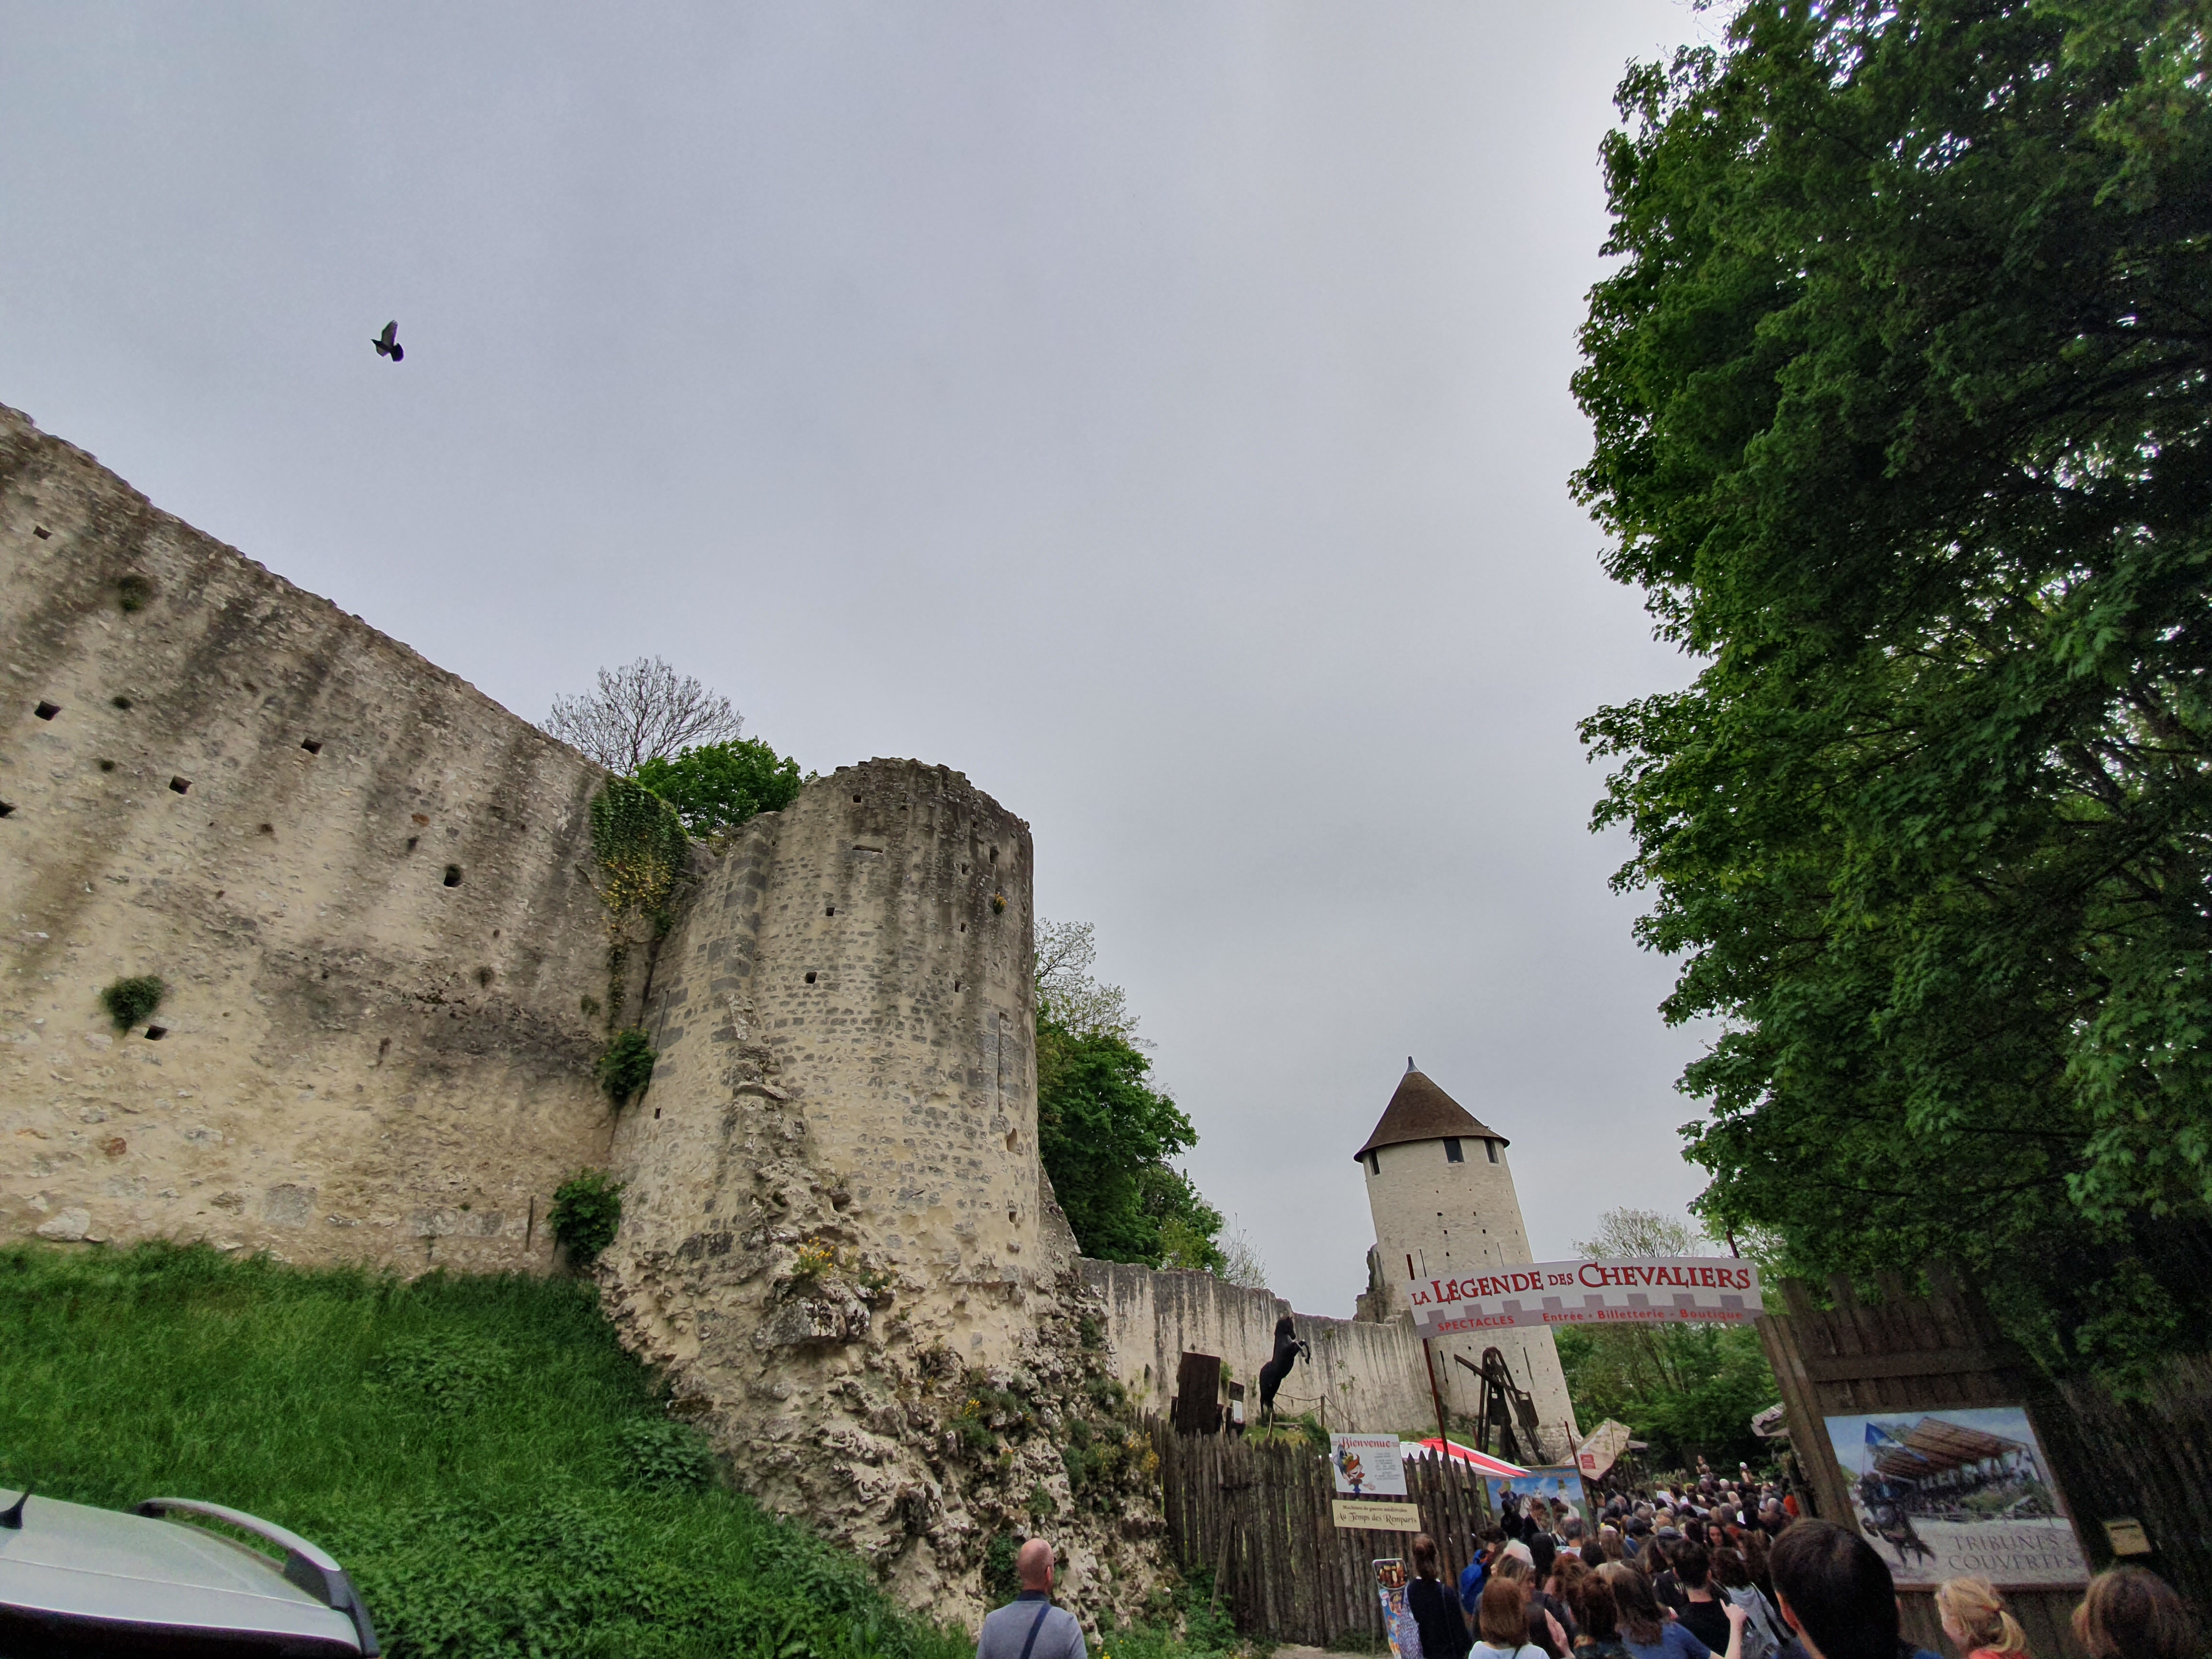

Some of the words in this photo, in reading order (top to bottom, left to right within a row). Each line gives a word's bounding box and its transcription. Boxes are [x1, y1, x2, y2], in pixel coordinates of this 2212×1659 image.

[1411, 1291, 1431, 1306] LA
[1431, 1271, 1544, 1304] LÉGENDE
[1547, 1273, 1574, 1286] DES
[1578, 1262, 1751, 1290] CHEVALIERS
[1437, 1315, 1515, 1331] SPECTACLES
[1542, 1311, 1584, 1322] Entrée
[1597, 1309, 1665, 1319] Billetterie
[1680, 1309, 1743, 1321] Boutique
[1338, 1436, 1391, 1449] Bienvenue
[1337, 1512, 1346, 1521] Au
[1348, 1512, 1370, 1524] Temps
[1371, 1513, 1382, 1522] des
[1383, 1514, 1417, 1526] Remparts
[1949, 1534, 2060, 1551] TRIBUNES
[1948, 1554, 2077, 1570] COUVERTES
